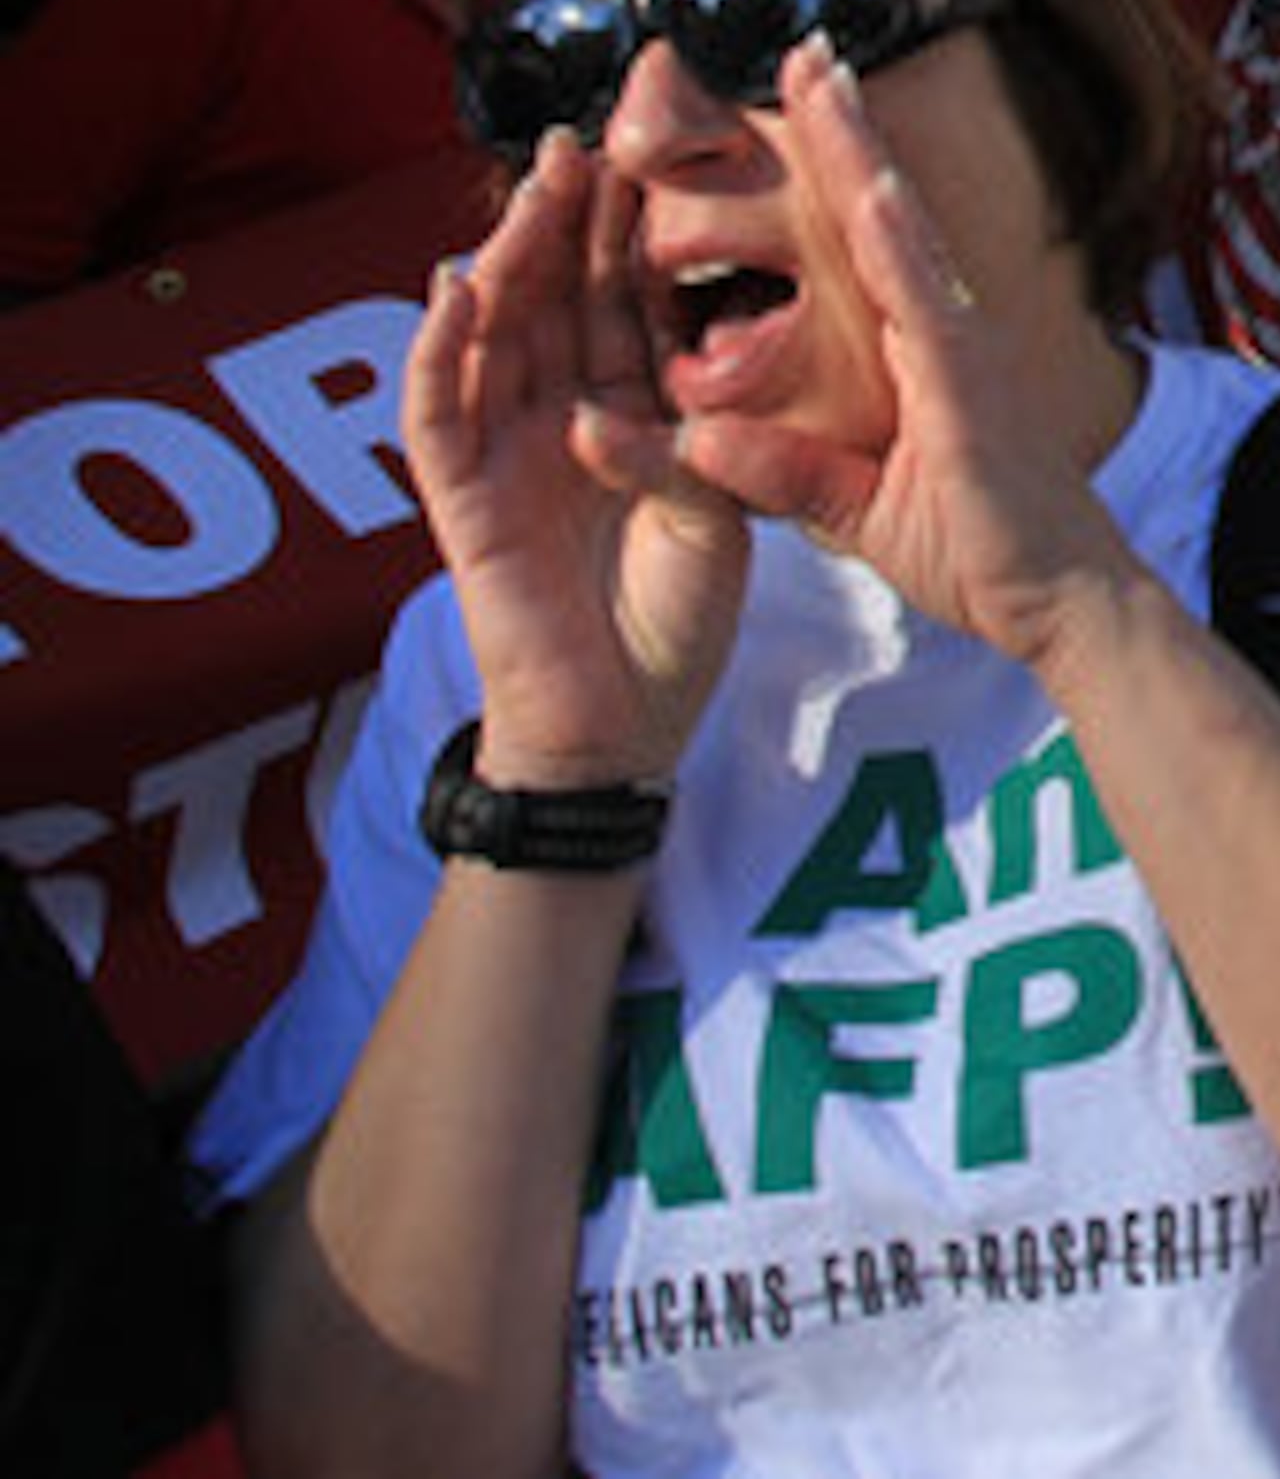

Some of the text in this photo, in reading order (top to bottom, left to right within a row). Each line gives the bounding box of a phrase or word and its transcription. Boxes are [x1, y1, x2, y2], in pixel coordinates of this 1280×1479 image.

[583, 920, 1254, 1214] AFP
[823, 1236, 924, 1325] FOR
[944, 1186, 1272, 1303] PROSPERITY
